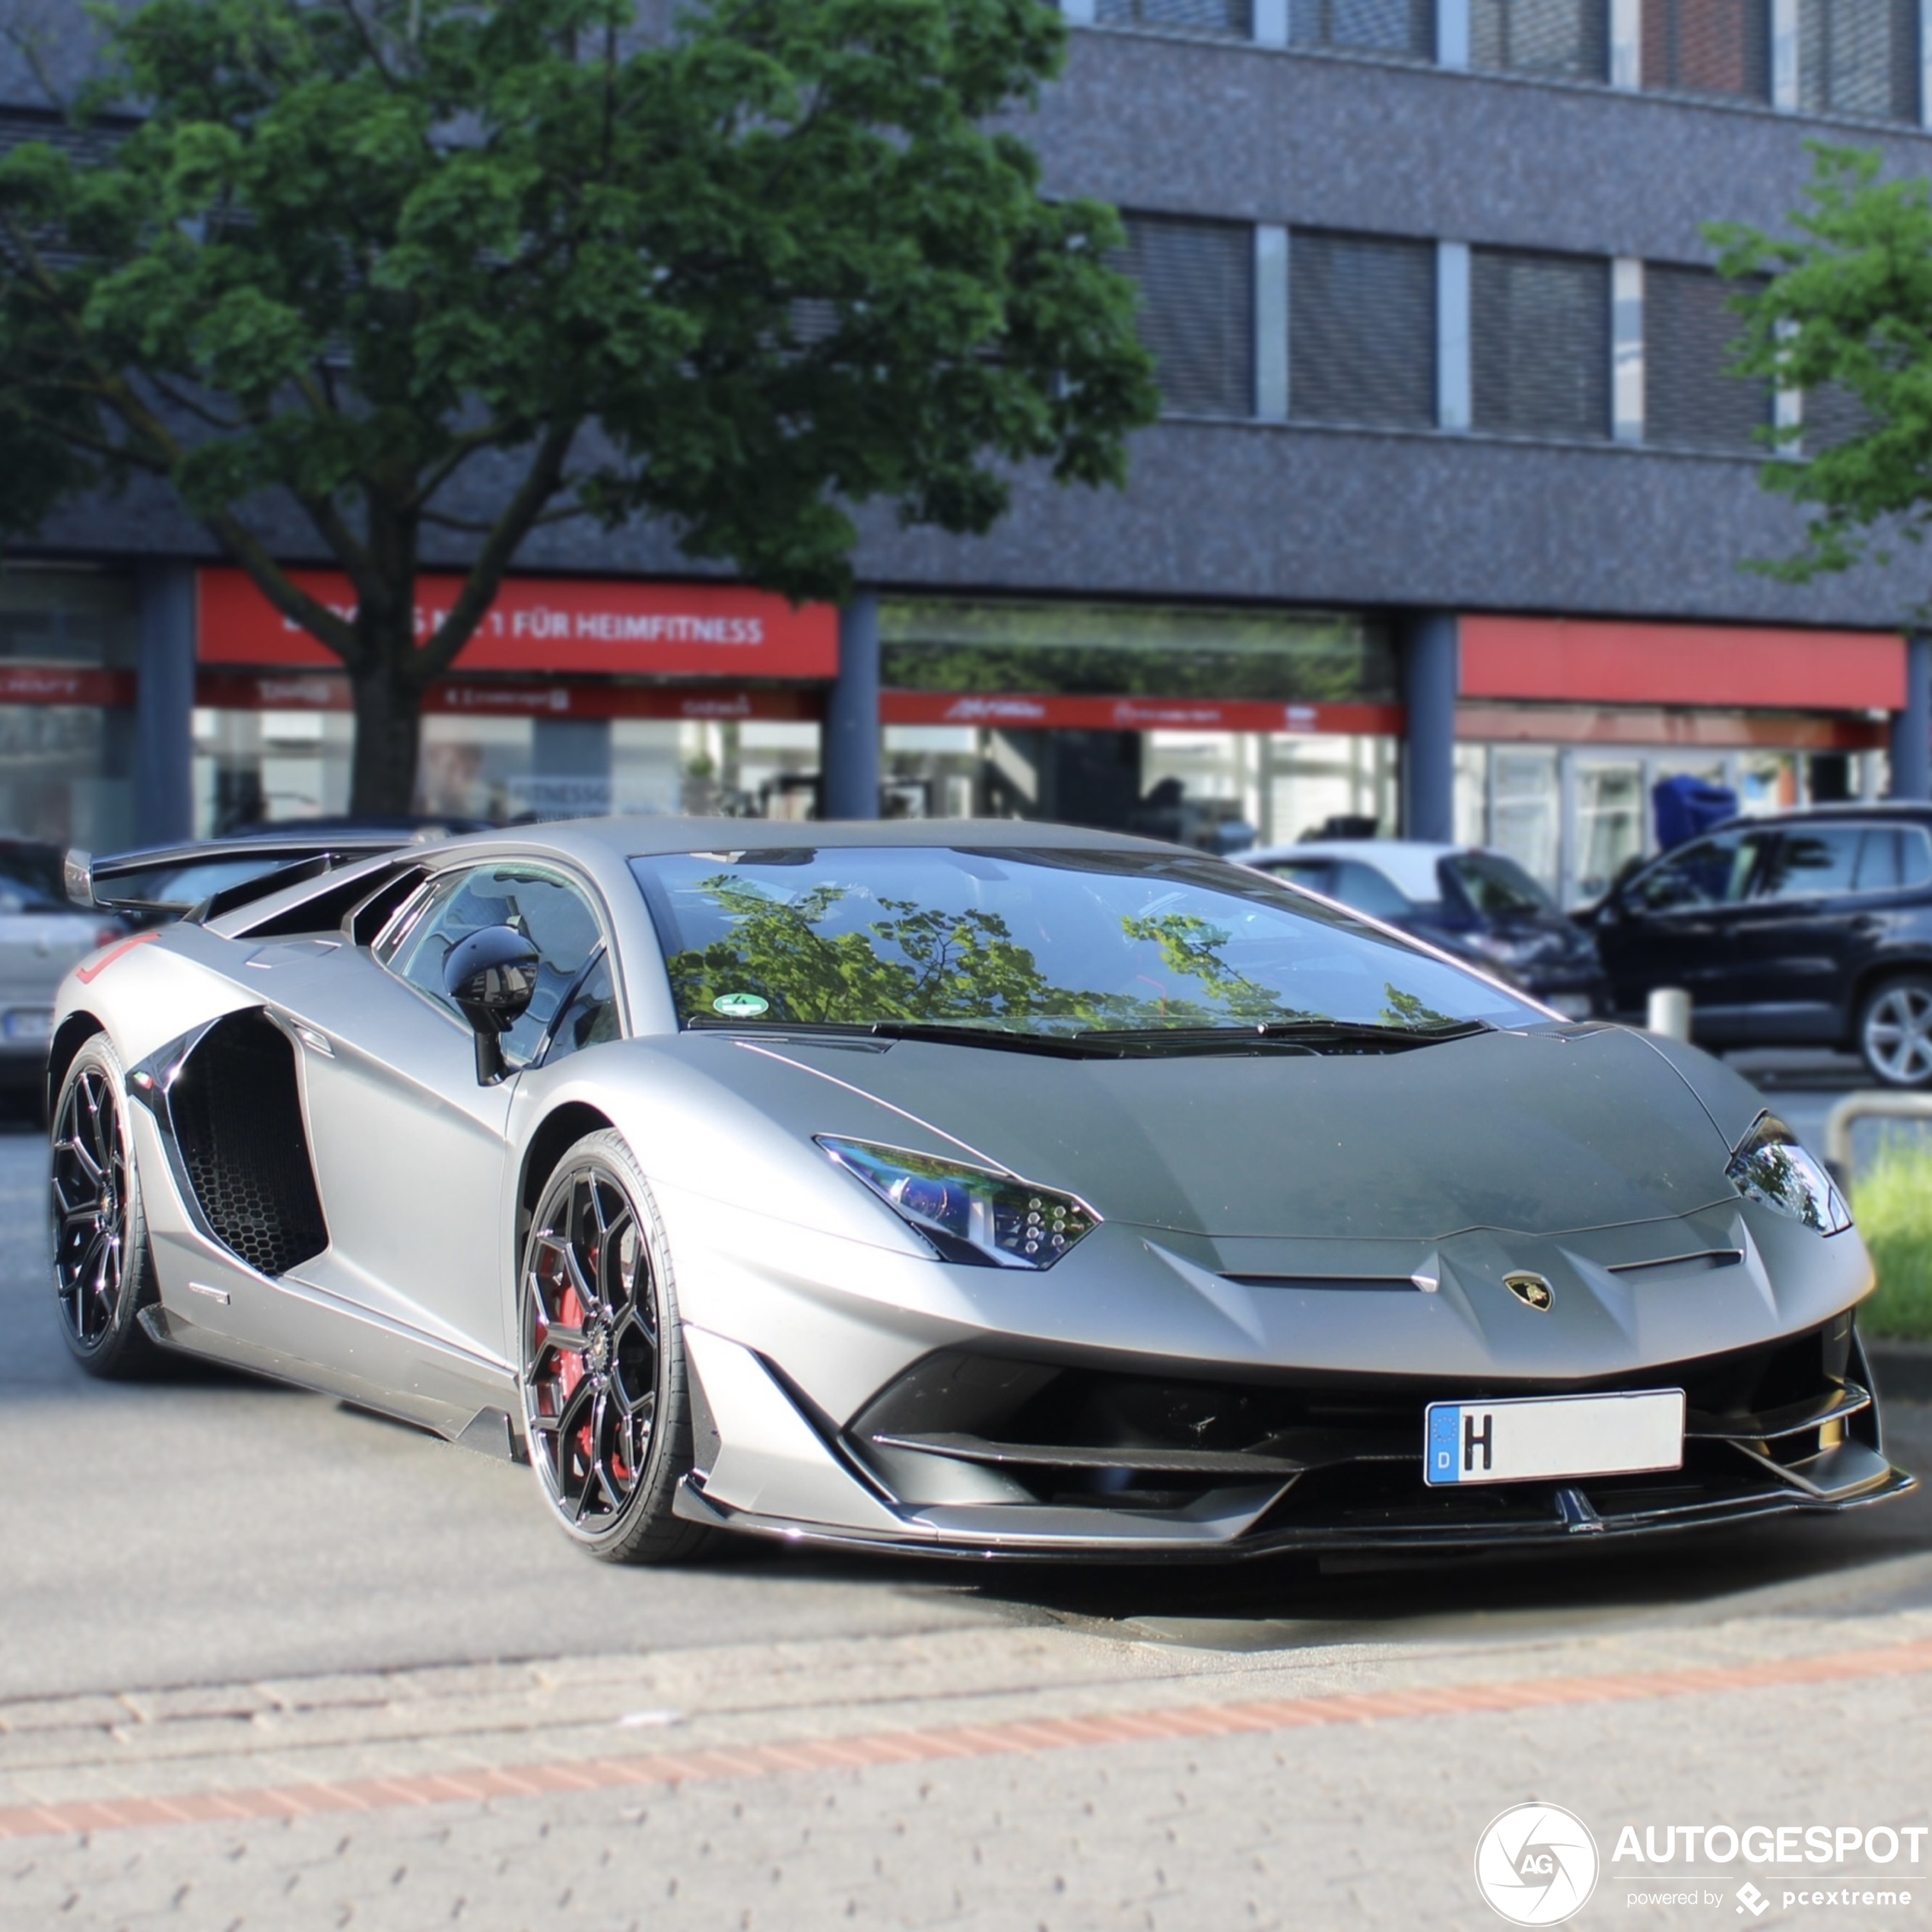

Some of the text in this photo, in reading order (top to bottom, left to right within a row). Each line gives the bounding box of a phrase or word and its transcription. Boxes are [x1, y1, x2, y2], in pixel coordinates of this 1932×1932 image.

[513, 606, 570, 639] FÜR
[575, 612, 764, 644] HEIMFITNESS
[1438, 1451, 1451, 1470] D
[1464, 1414, 1492, 1471] H
